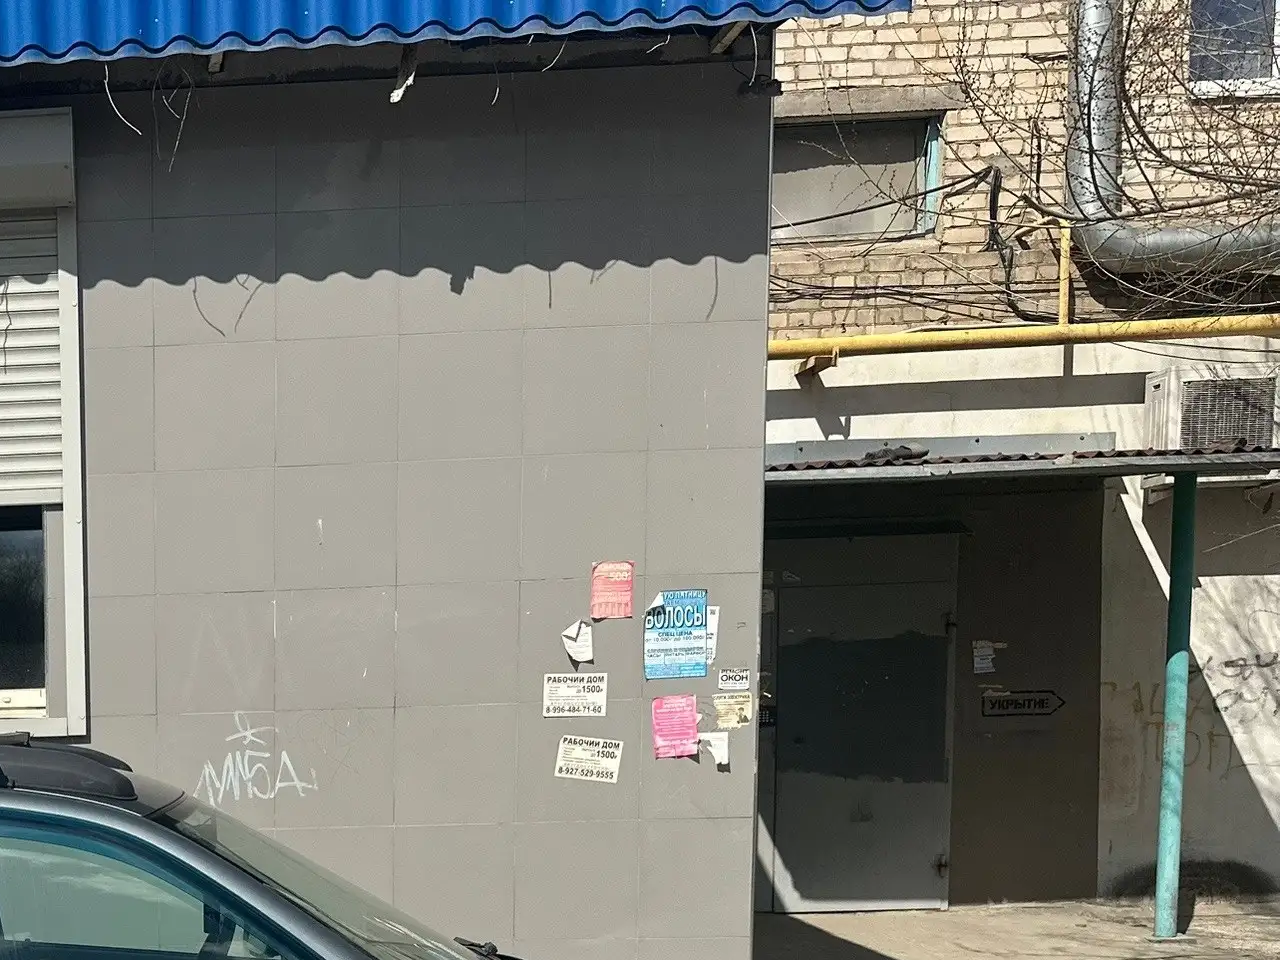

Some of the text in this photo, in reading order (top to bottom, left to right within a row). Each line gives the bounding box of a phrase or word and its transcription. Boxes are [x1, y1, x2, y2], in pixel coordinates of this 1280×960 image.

[645, 604, 706, 629] ВОЛОСЫ
[586, 676, 605, 684] ДОМ
[720, 674, 748, 682] ОКОН
[989, 698, 1049, 710] УКРЫТИЕ
[601, 741, 620, 749] ДОМ
